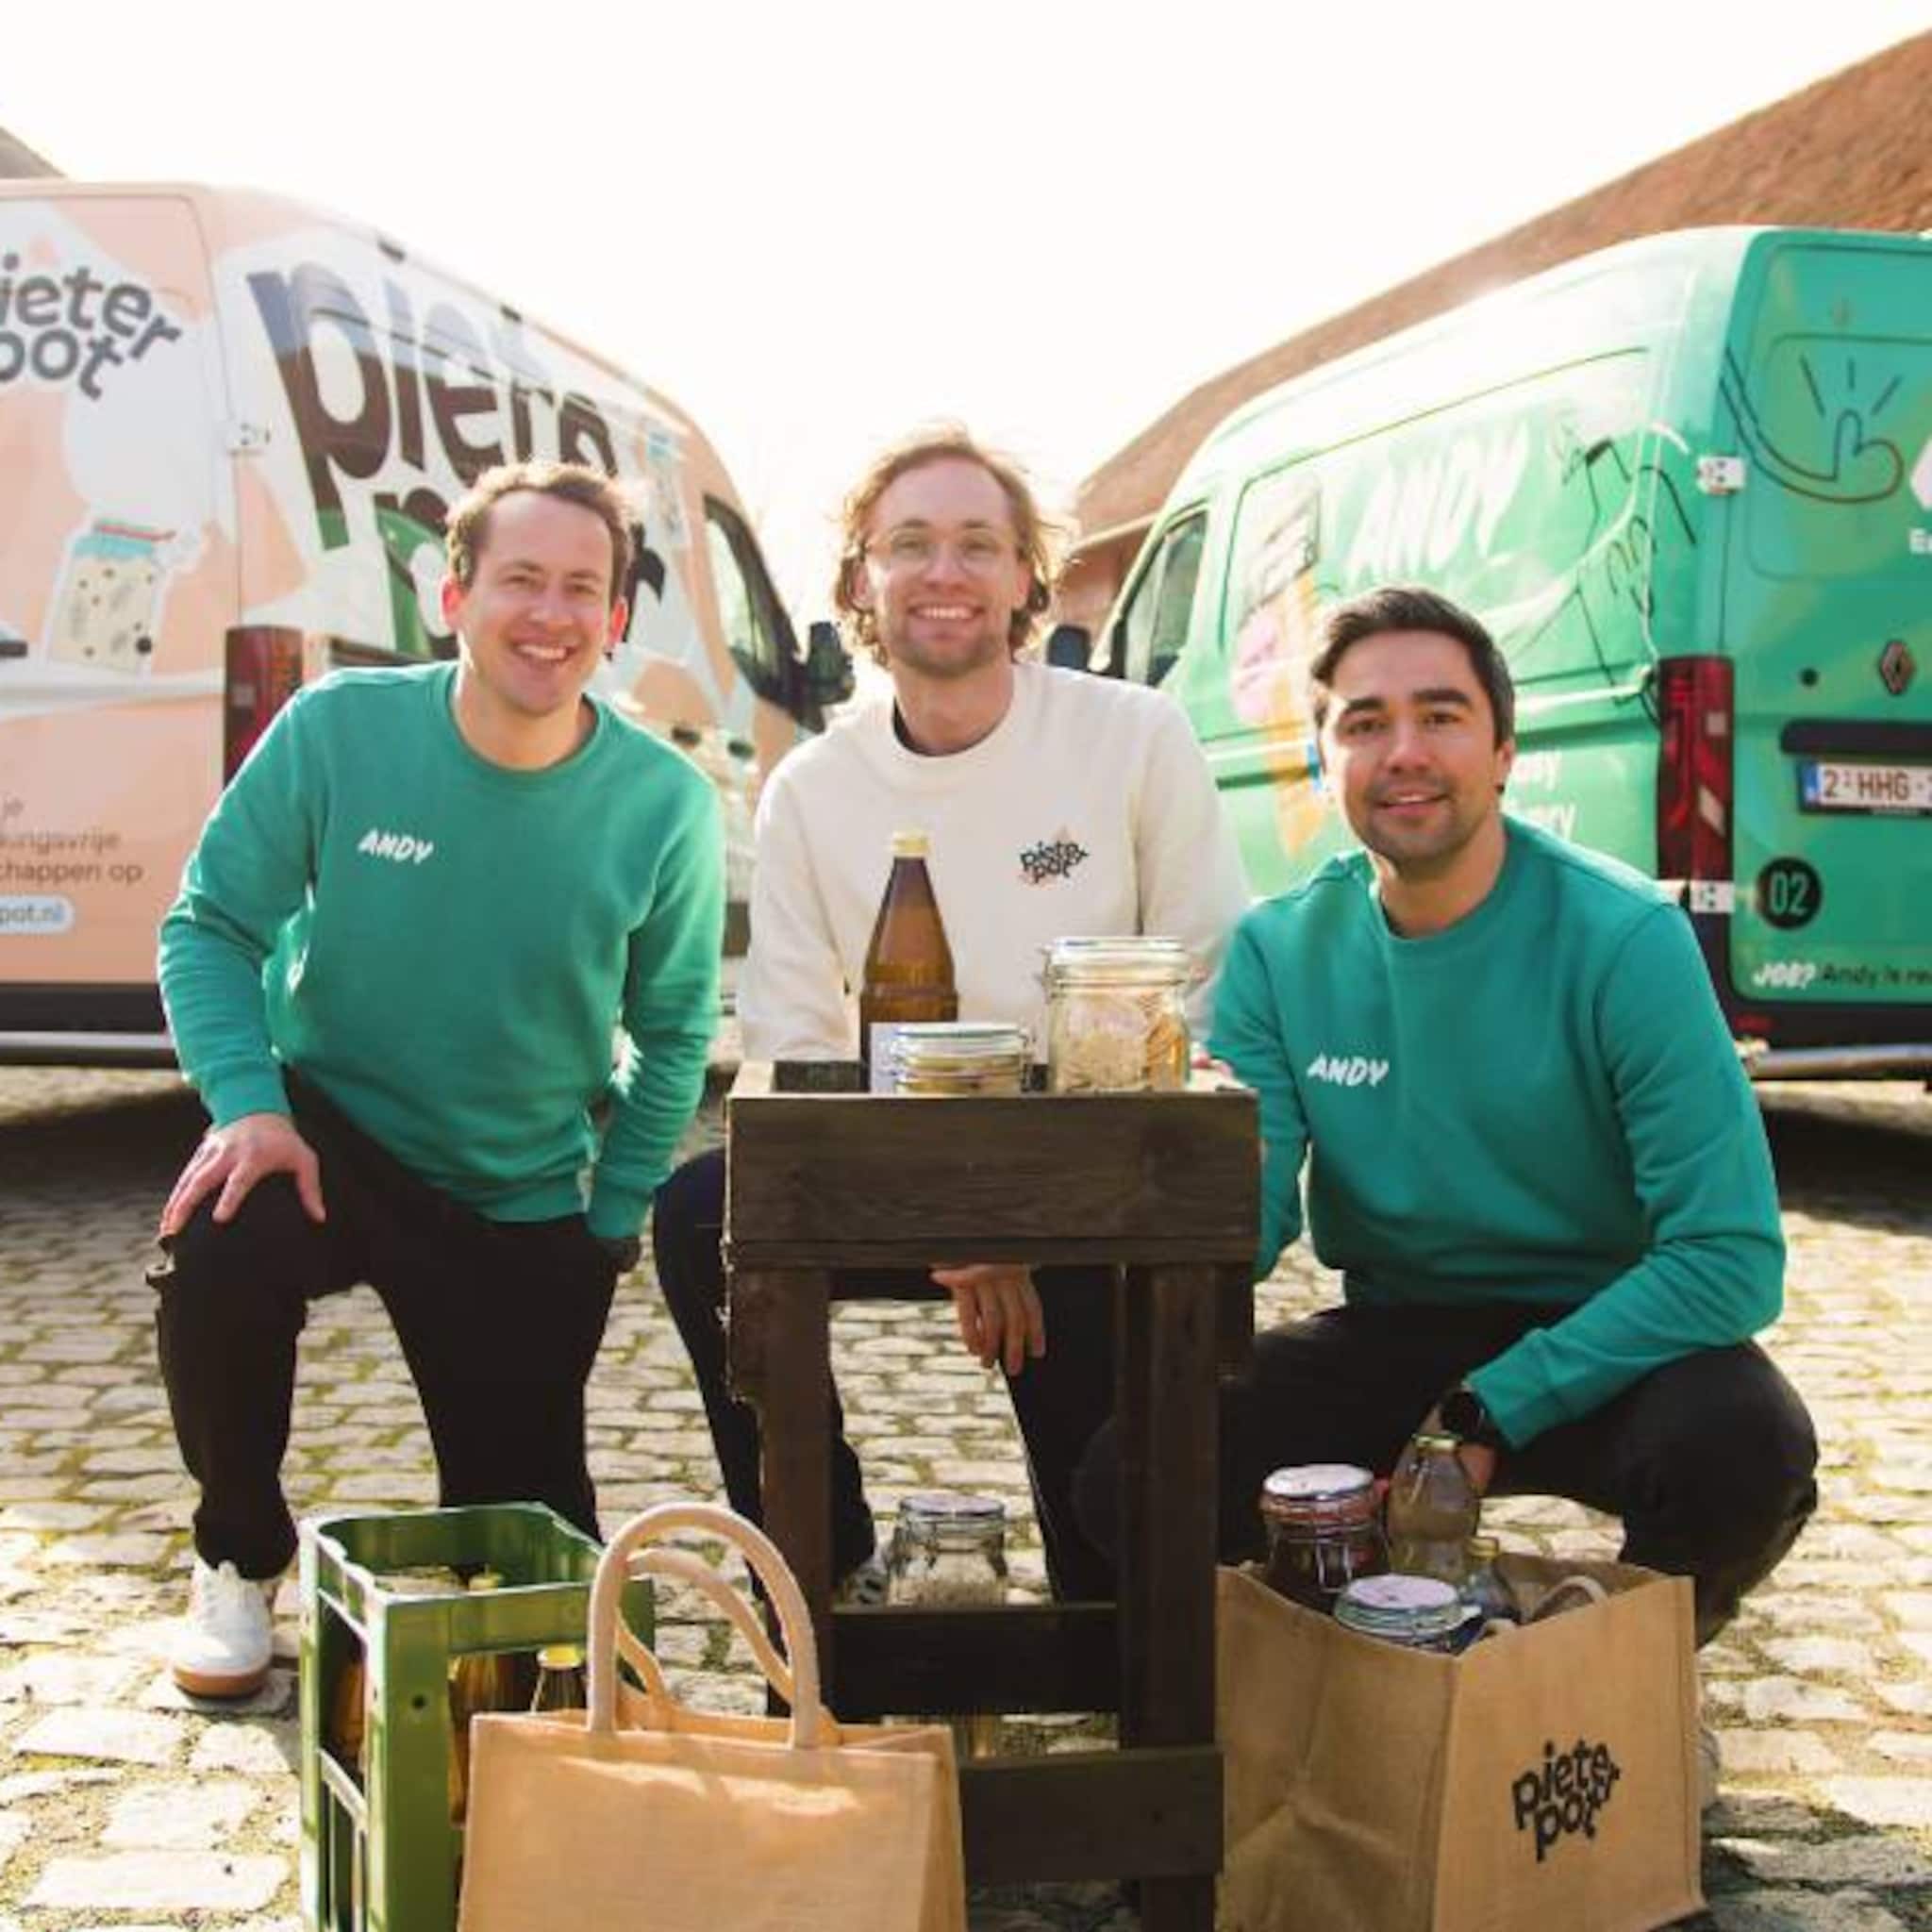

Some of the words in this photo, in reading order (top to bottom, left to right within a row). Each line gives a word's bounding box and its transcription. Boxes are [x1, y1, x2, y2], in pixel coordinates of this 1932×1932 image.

[357, 827, 435, 865] ANDY
[108, 863, 143, 887] op
[1772, 872, 1809, 915] 02
[1753, 962, 1816, 989] JOB?
[1824, 962, 1875, 990] Andy
[1306, 1052, 1389, 1087] ANDY
[1512, 1739, 1621, 1830] pieter
[1535, 1790, 1601, 1863] pot
